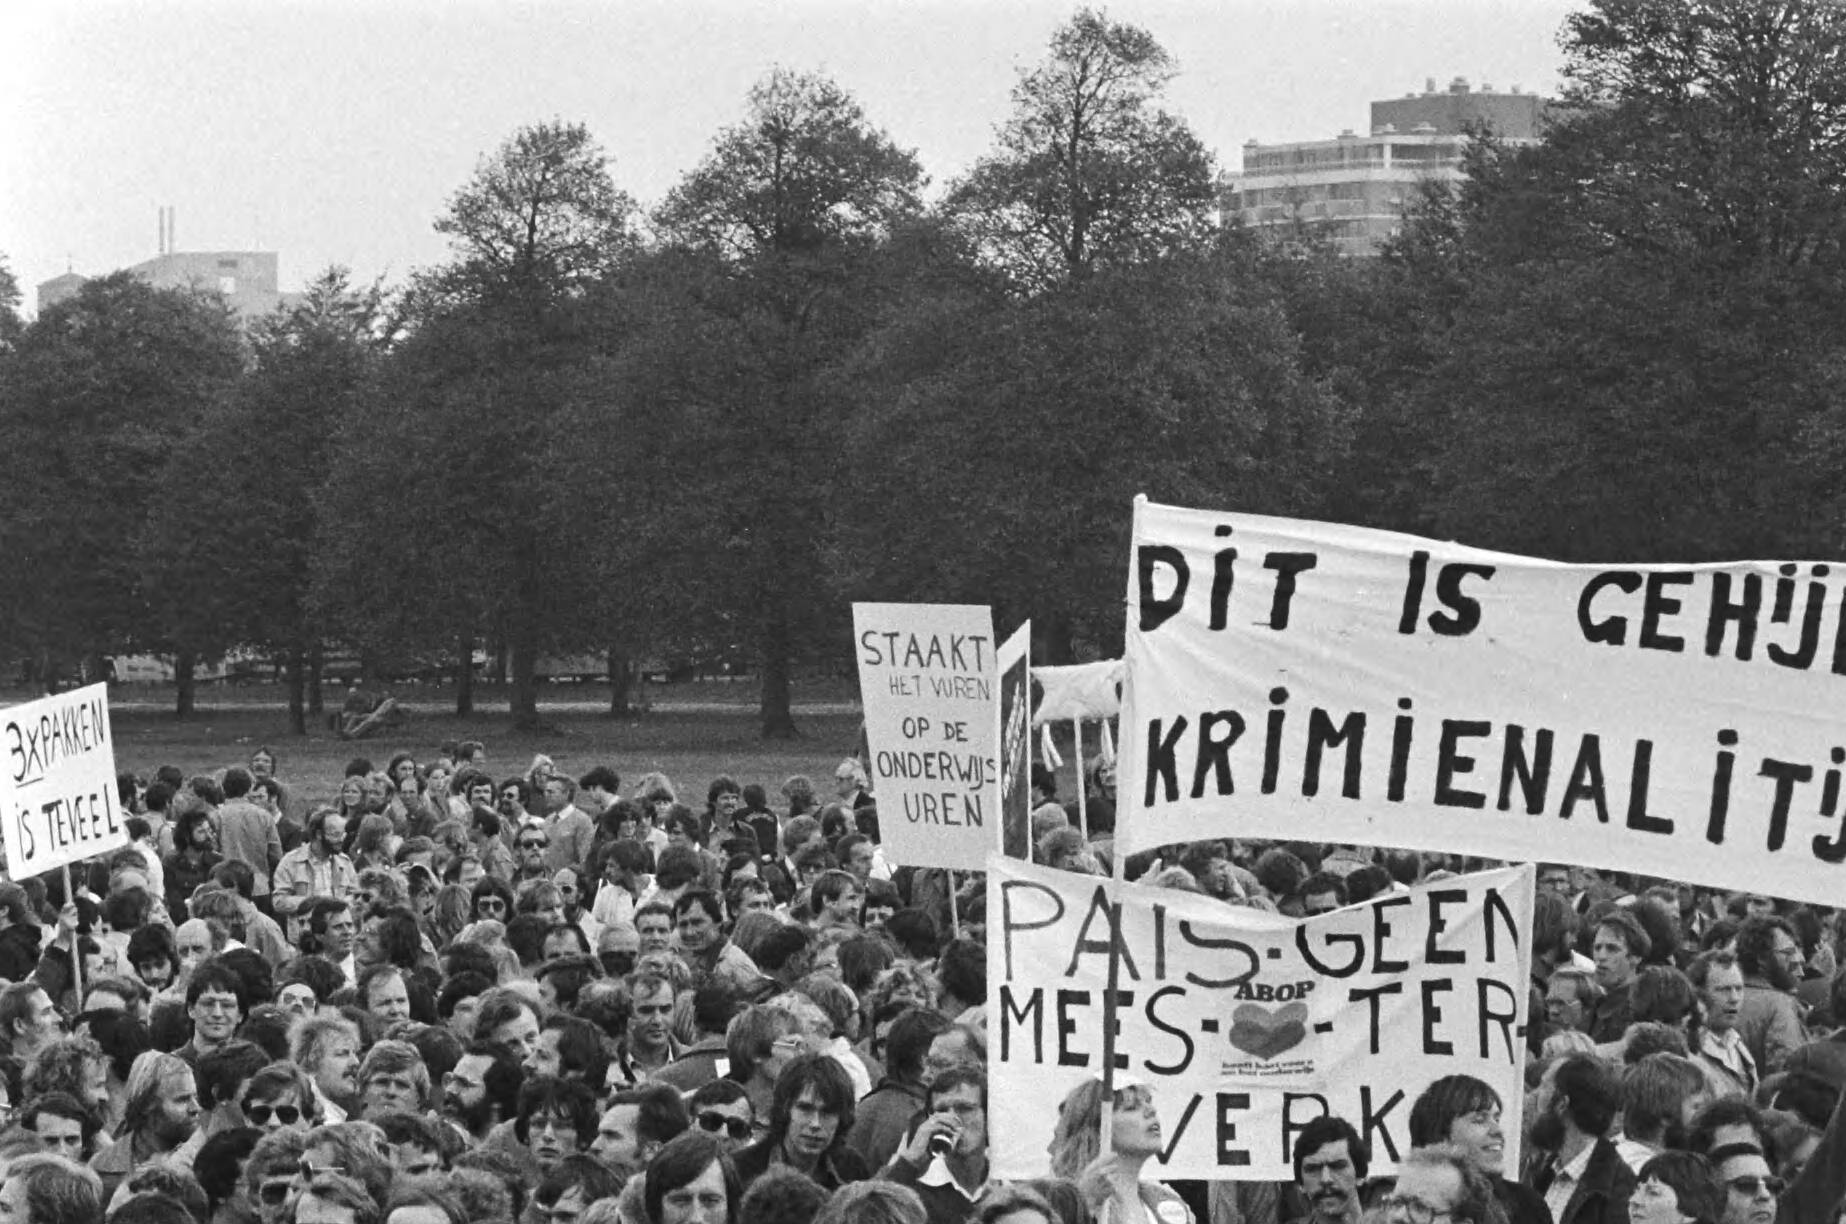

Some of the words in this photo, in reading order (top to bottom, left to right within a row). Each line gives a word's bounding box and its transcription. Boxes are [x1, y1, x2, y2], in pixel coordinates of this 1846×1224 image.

[1399, 550, 1495, 636] IS
[861, 630, 988, 672] STAAKT
[889, 674, 921, 696] HET
[930, 675, 991, 701] VUREN
[902, 716, 930, 739] OP
[942, 721, 969, 742] DE
[877, 751, 996, 790] ONDERWIJS
[904, 793, 984, 827] UREN
[1233, 980, 1316, 1002] ABOP
